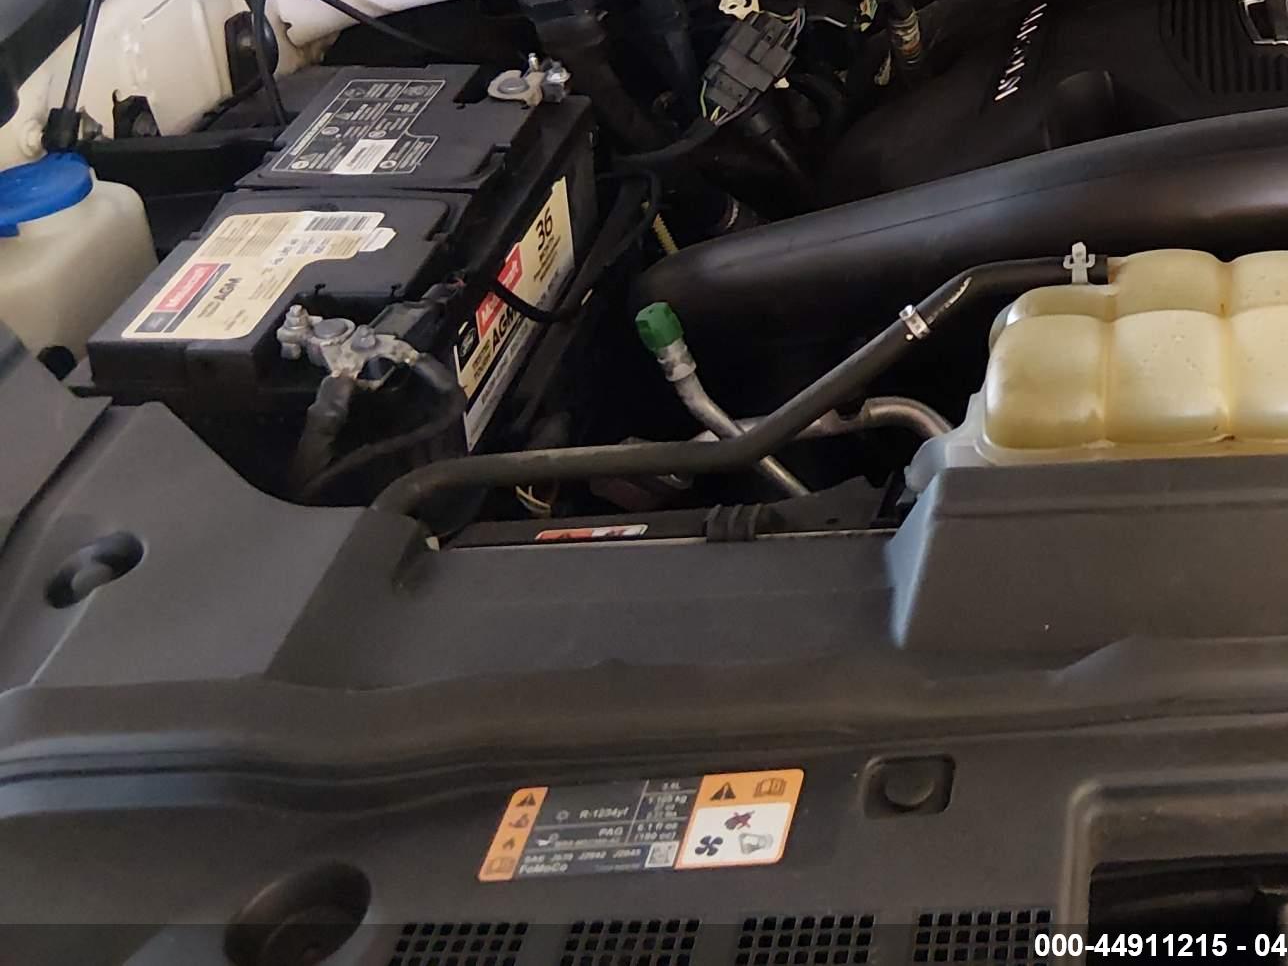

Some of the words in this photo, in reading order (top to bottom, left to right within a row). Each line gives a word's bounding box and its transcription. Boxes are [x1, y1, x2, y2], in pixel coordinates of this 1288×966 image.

[535, 206, 553, 251] 36
[219, 277, 241, 302] AGM
[579, 807, 630, 820] R-1234yf
[598, 827, 623, 837] PAG
[519, 862, 568, 875] FoMoCo
